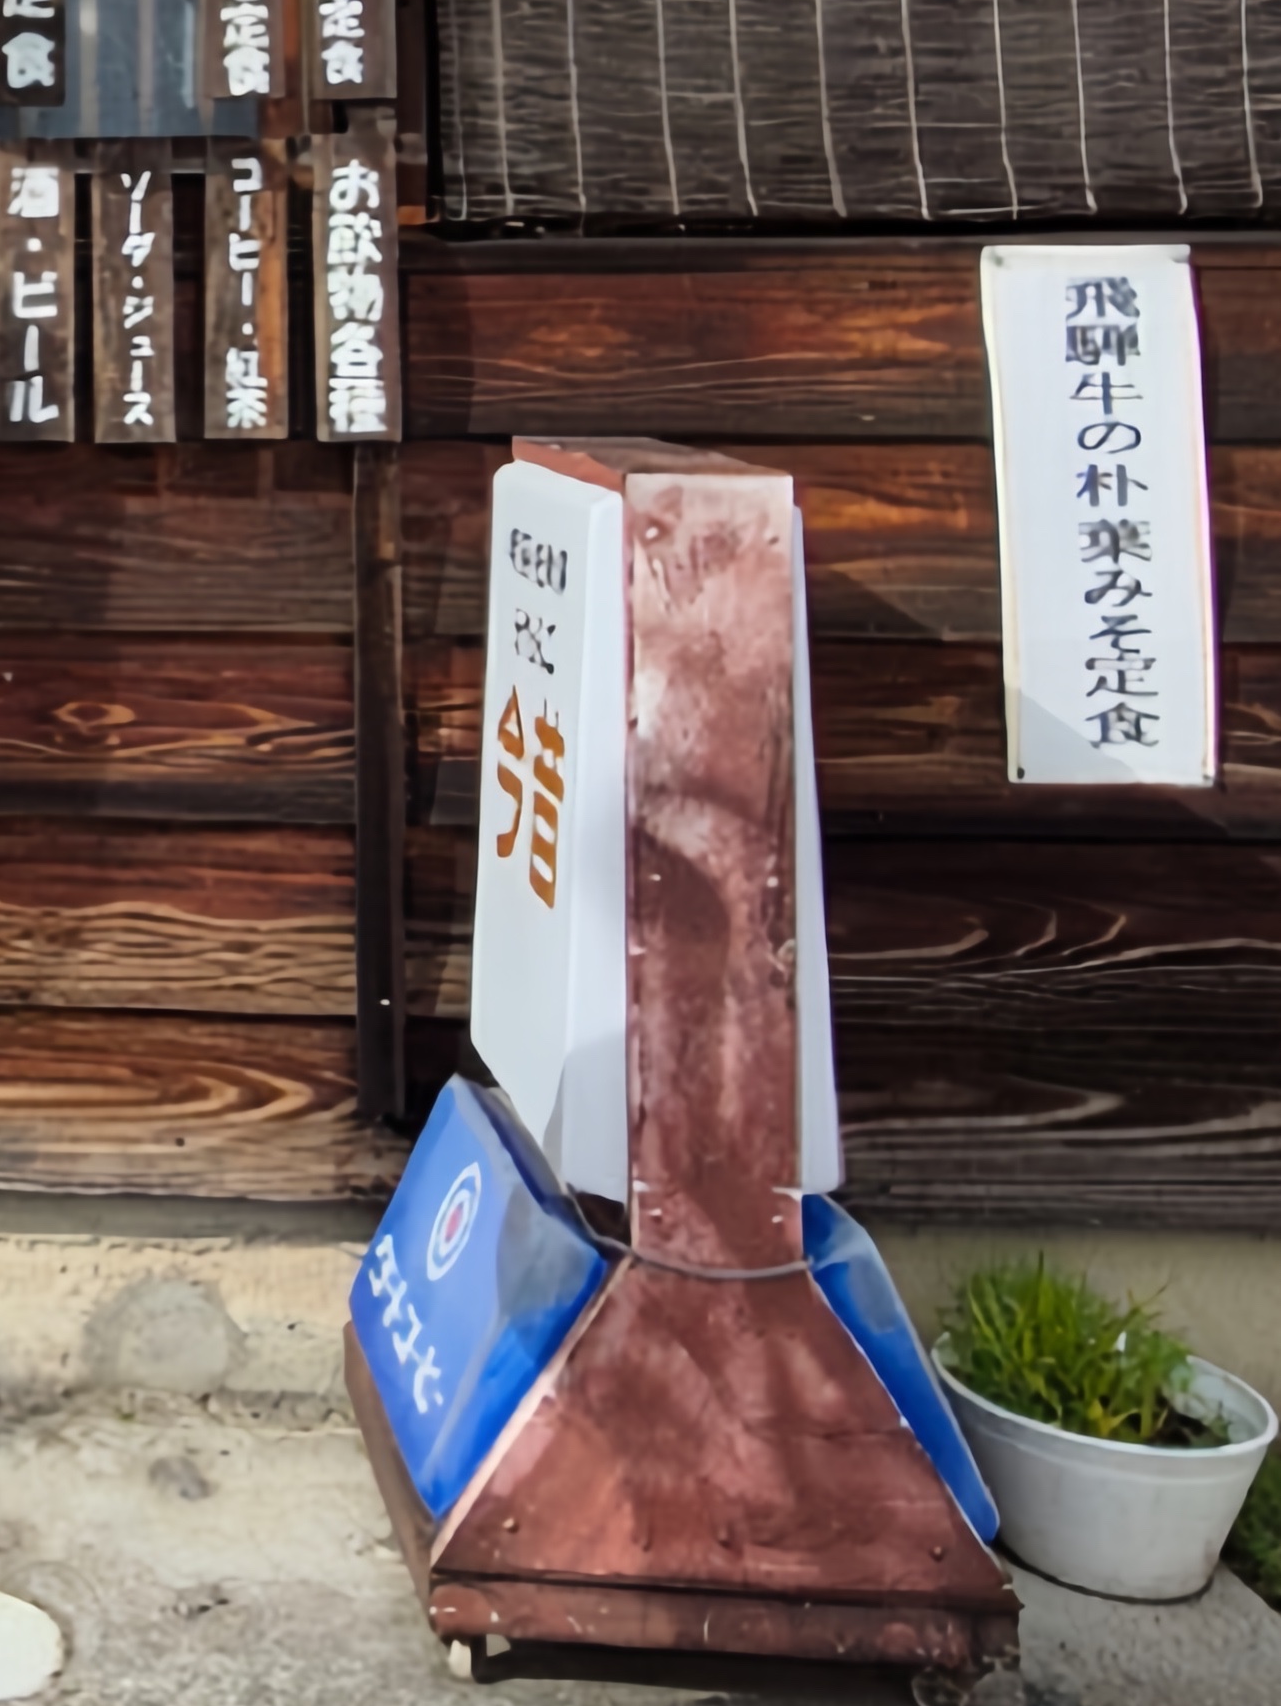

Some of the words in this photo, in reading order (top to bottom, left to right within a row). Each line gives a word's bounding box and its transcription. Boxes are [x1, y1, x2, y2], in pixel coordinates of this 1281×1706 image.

[7, 166, 59, 423] 酒・ビール
[225, 157, 268, 428] コーヒー・紅茶
[327, 159, 387, 432] お飲物各種
[496, 684, 565, 909] 今昔
